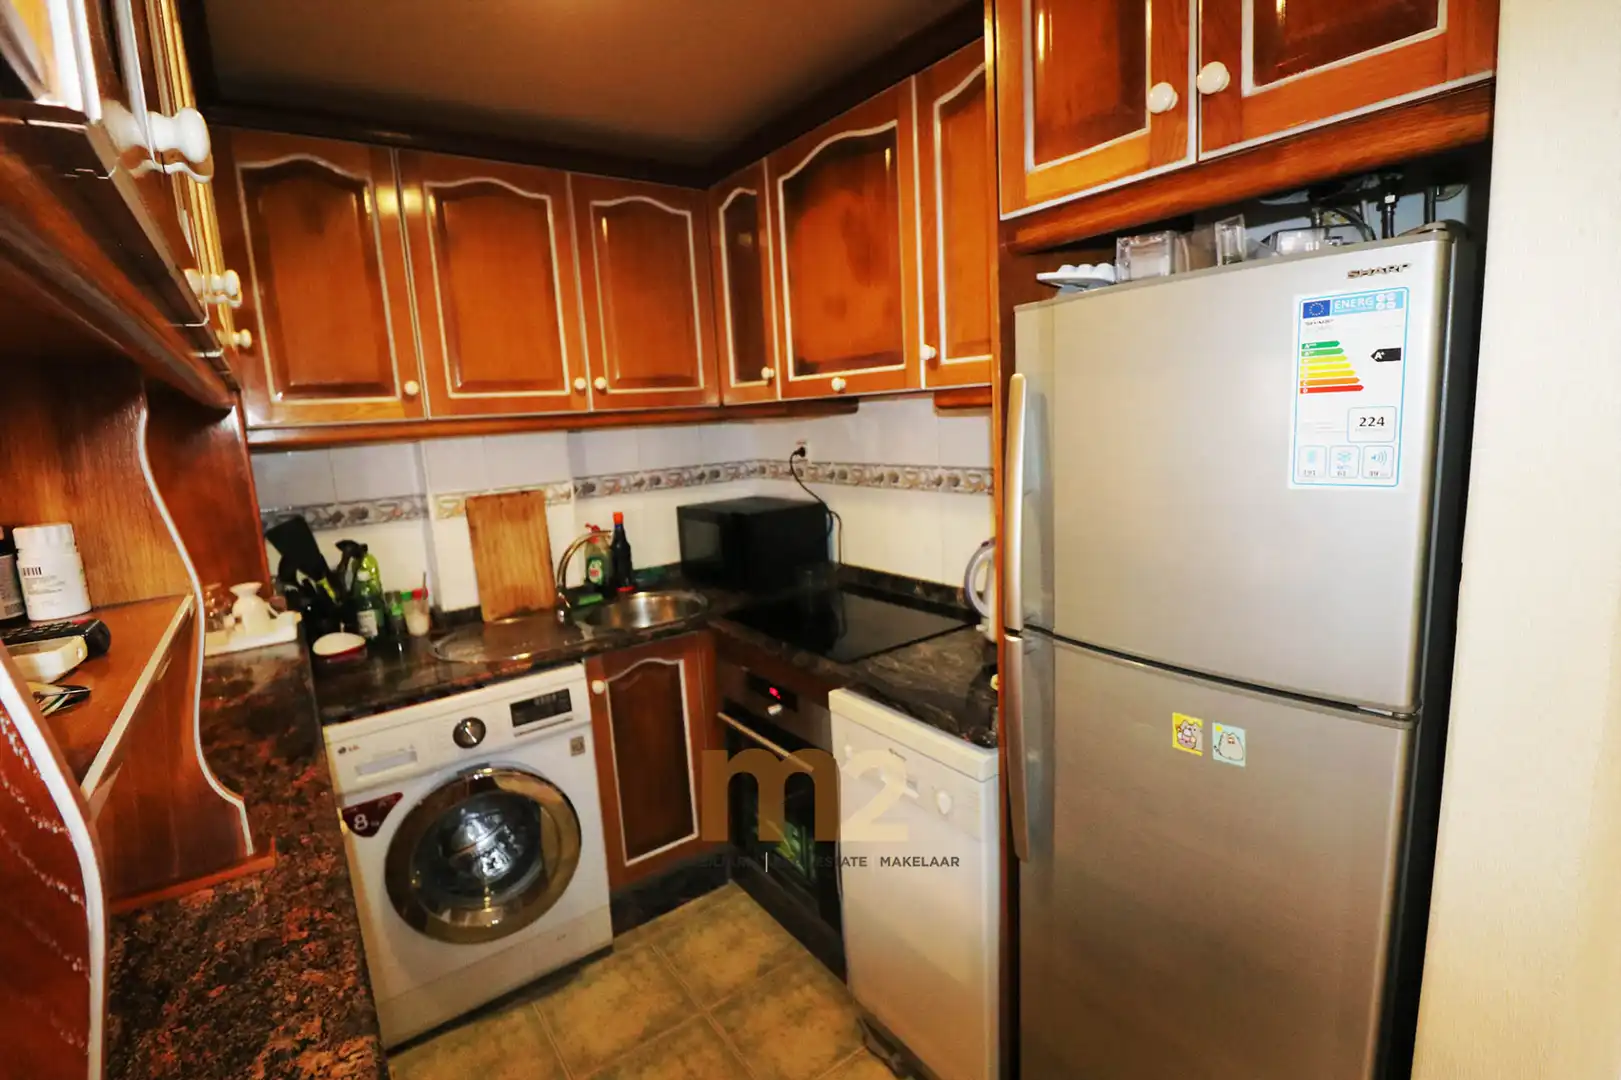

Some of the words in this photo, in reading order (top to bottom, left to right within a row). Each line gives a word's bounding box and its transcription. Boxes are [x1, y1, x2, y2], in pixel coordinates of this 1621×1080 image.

[1334, 297, 1373, 309] ENERG
[1359, 416, 1385, 427] 224
[353, 813, 369, 831] 8
